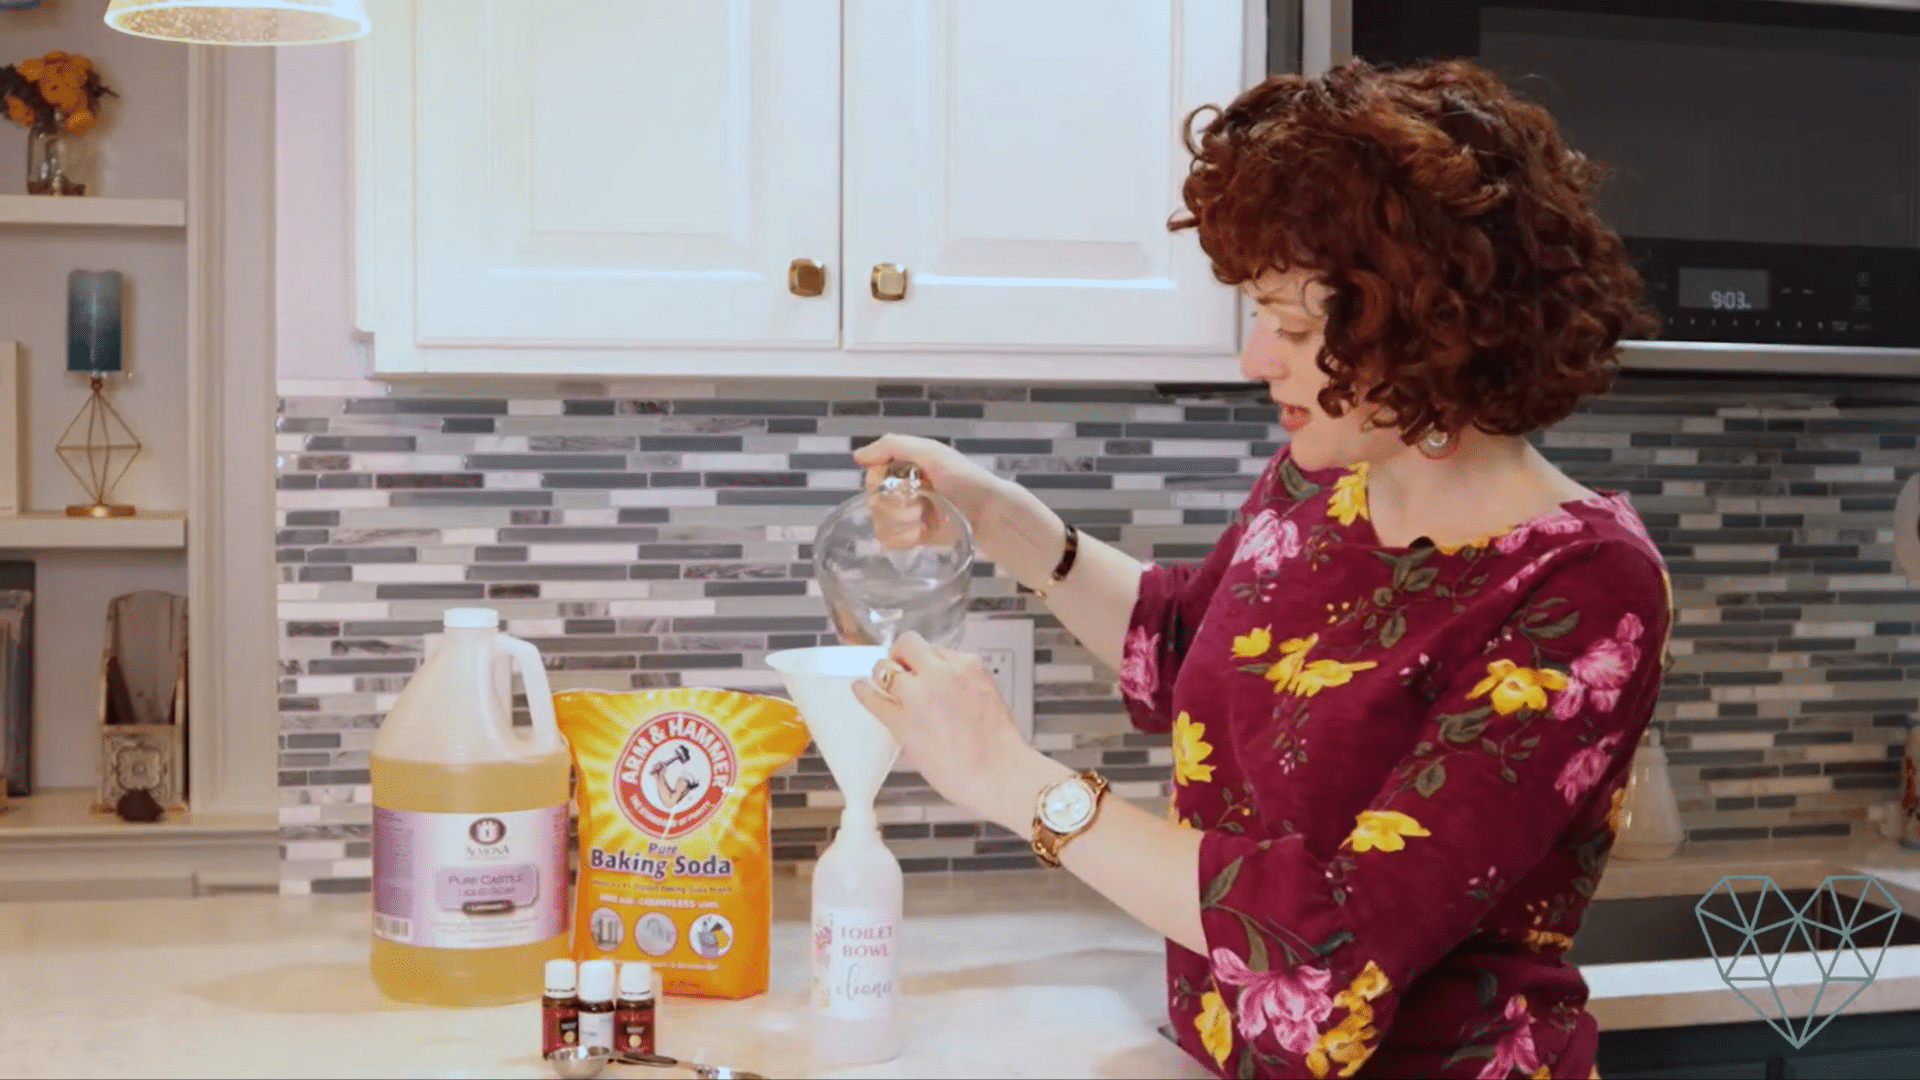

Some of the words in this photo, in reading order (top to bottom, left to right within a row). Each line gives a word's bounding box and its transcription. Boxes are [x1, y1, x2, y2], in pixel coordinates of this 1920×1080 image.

[621, 736, 654, 784] ARM
[648, 725, 668, 744] &
[667, 715, 730, 787] HAMMER
[648, 842, 678, 855] Pure
[591, 849, 667, 880] Baking
[674, 854, 732, 875] Soda
[841, 925, 892, 939] TOILET
[843, 944, 891, 957] BOWL
